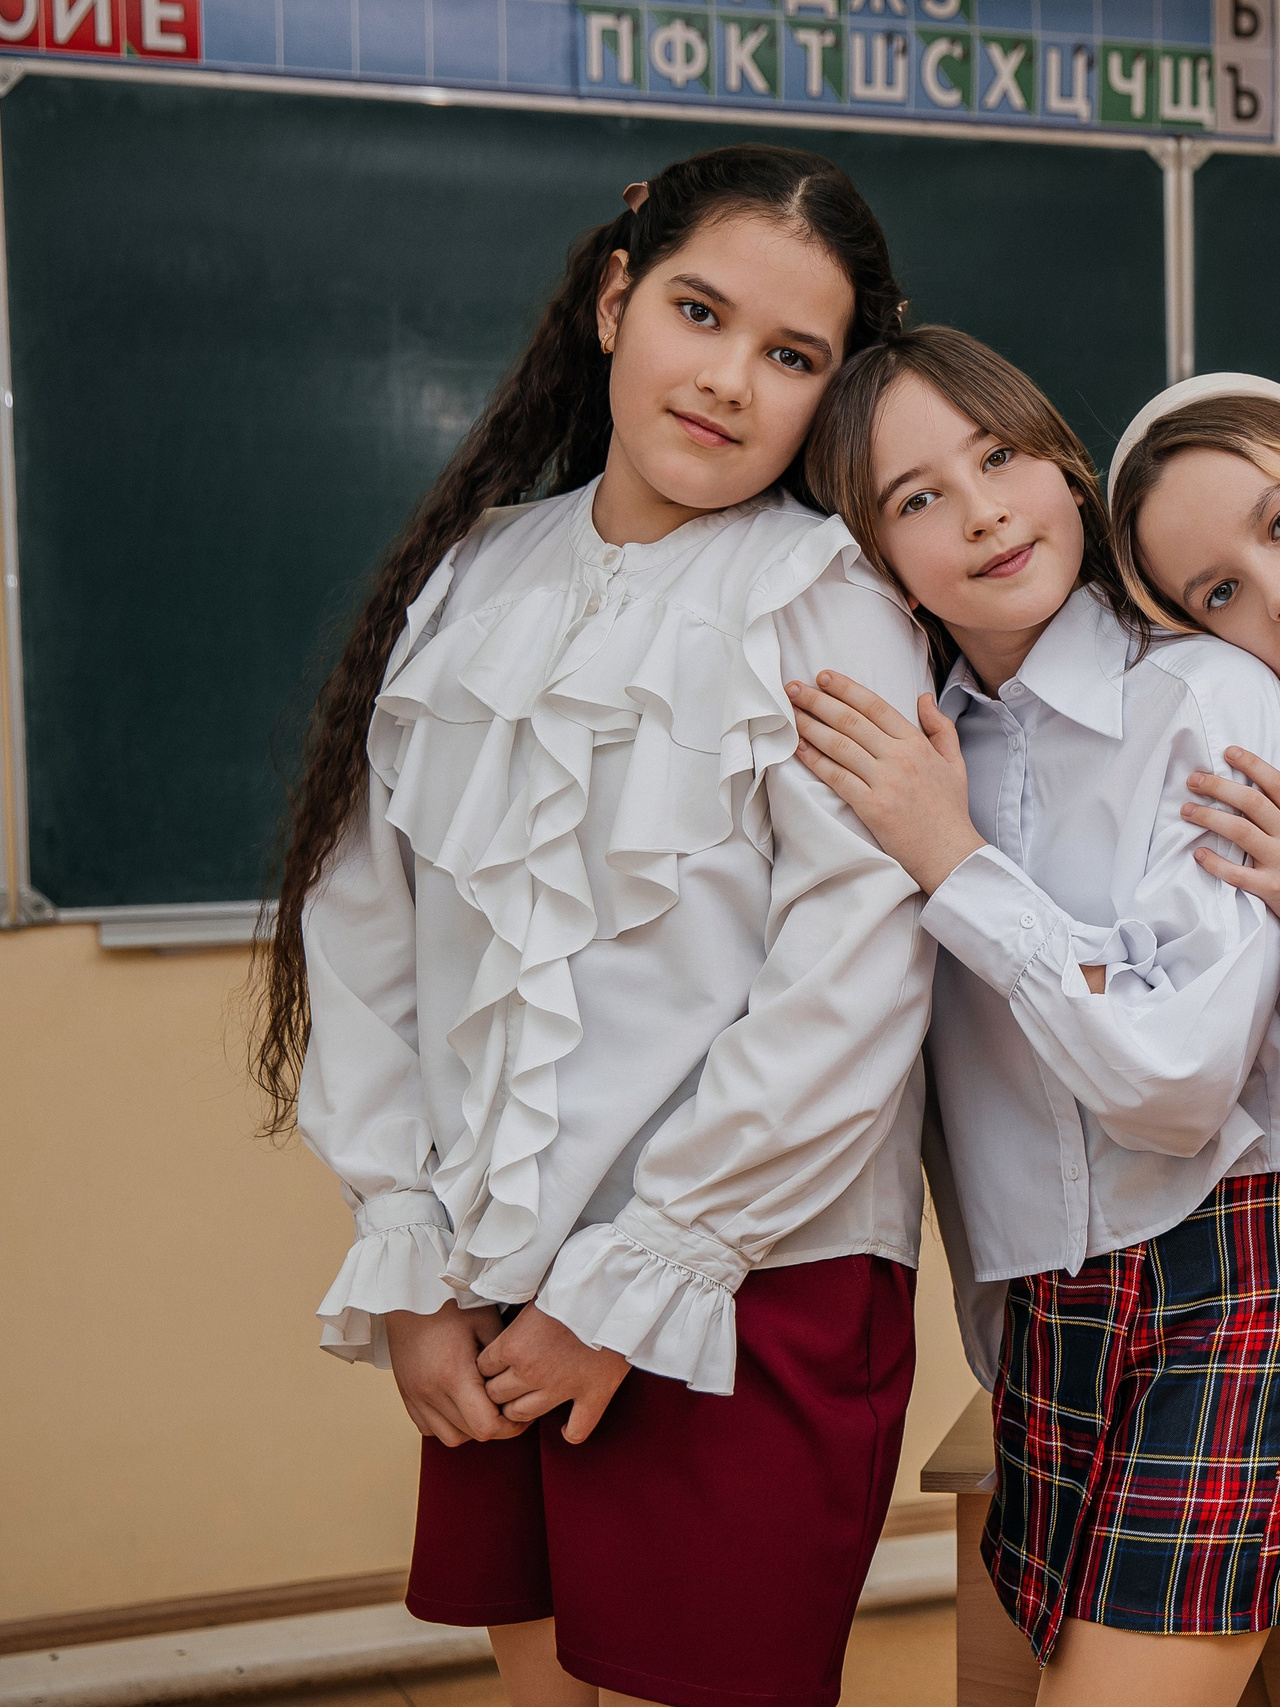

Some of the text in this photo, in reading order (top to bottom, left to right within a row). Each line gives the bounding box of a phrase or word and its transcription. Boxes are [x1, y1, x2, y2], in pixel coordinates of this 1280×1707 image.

[586, 13, 1260, 131] П Ф К Т Ш С Х Ц Ч Щ Ъ
